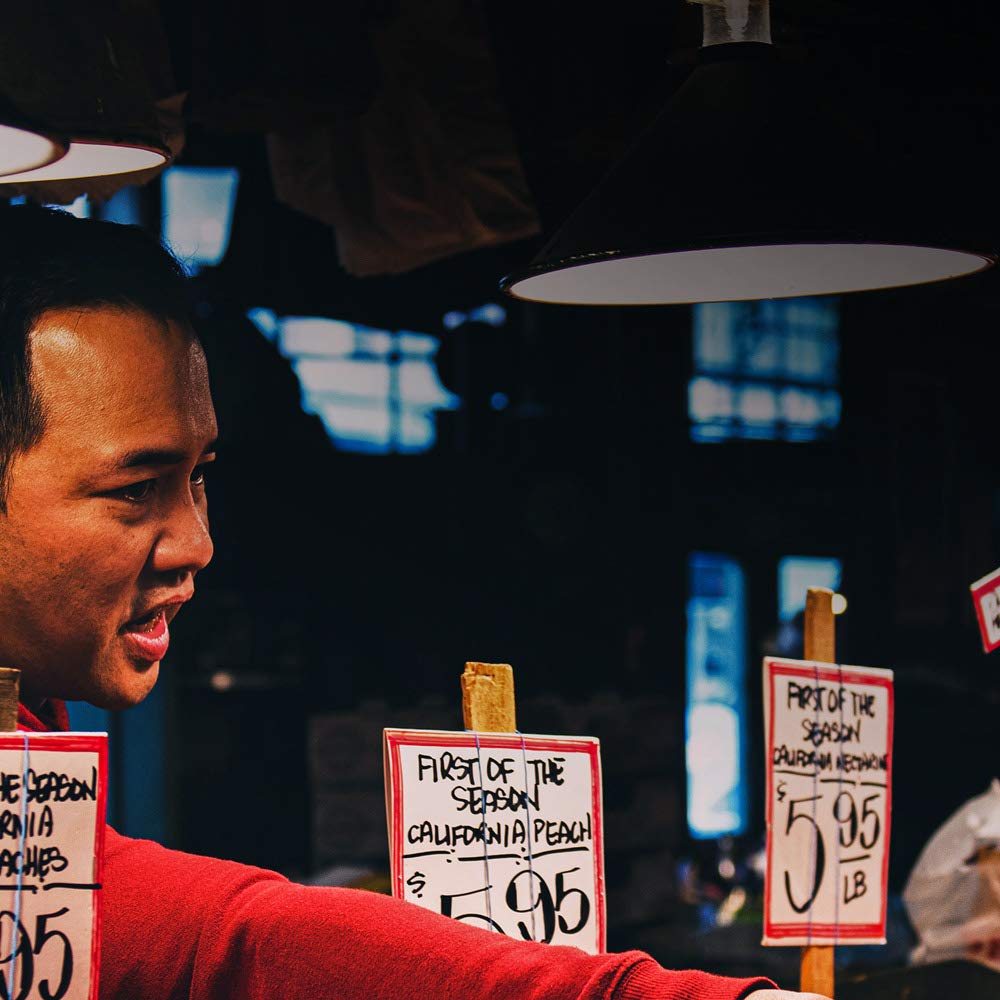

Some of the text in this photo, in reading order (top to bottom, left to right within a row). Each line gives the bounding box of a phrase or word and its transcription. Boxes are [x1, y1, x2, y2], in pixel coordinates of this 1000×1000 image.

[787, 682, 875, 718] FIRST OF THE
[801, 719, 861, 747] SEASON
[23, 766, 97, 802] SEASON
[418, 752, 566, 786] FIRST OF THE
[451, 785, 540, 815] SEASON
[407, 812, 592, 847] CALIFORNIA PEACH
[843, 870, 868, 904] LB
